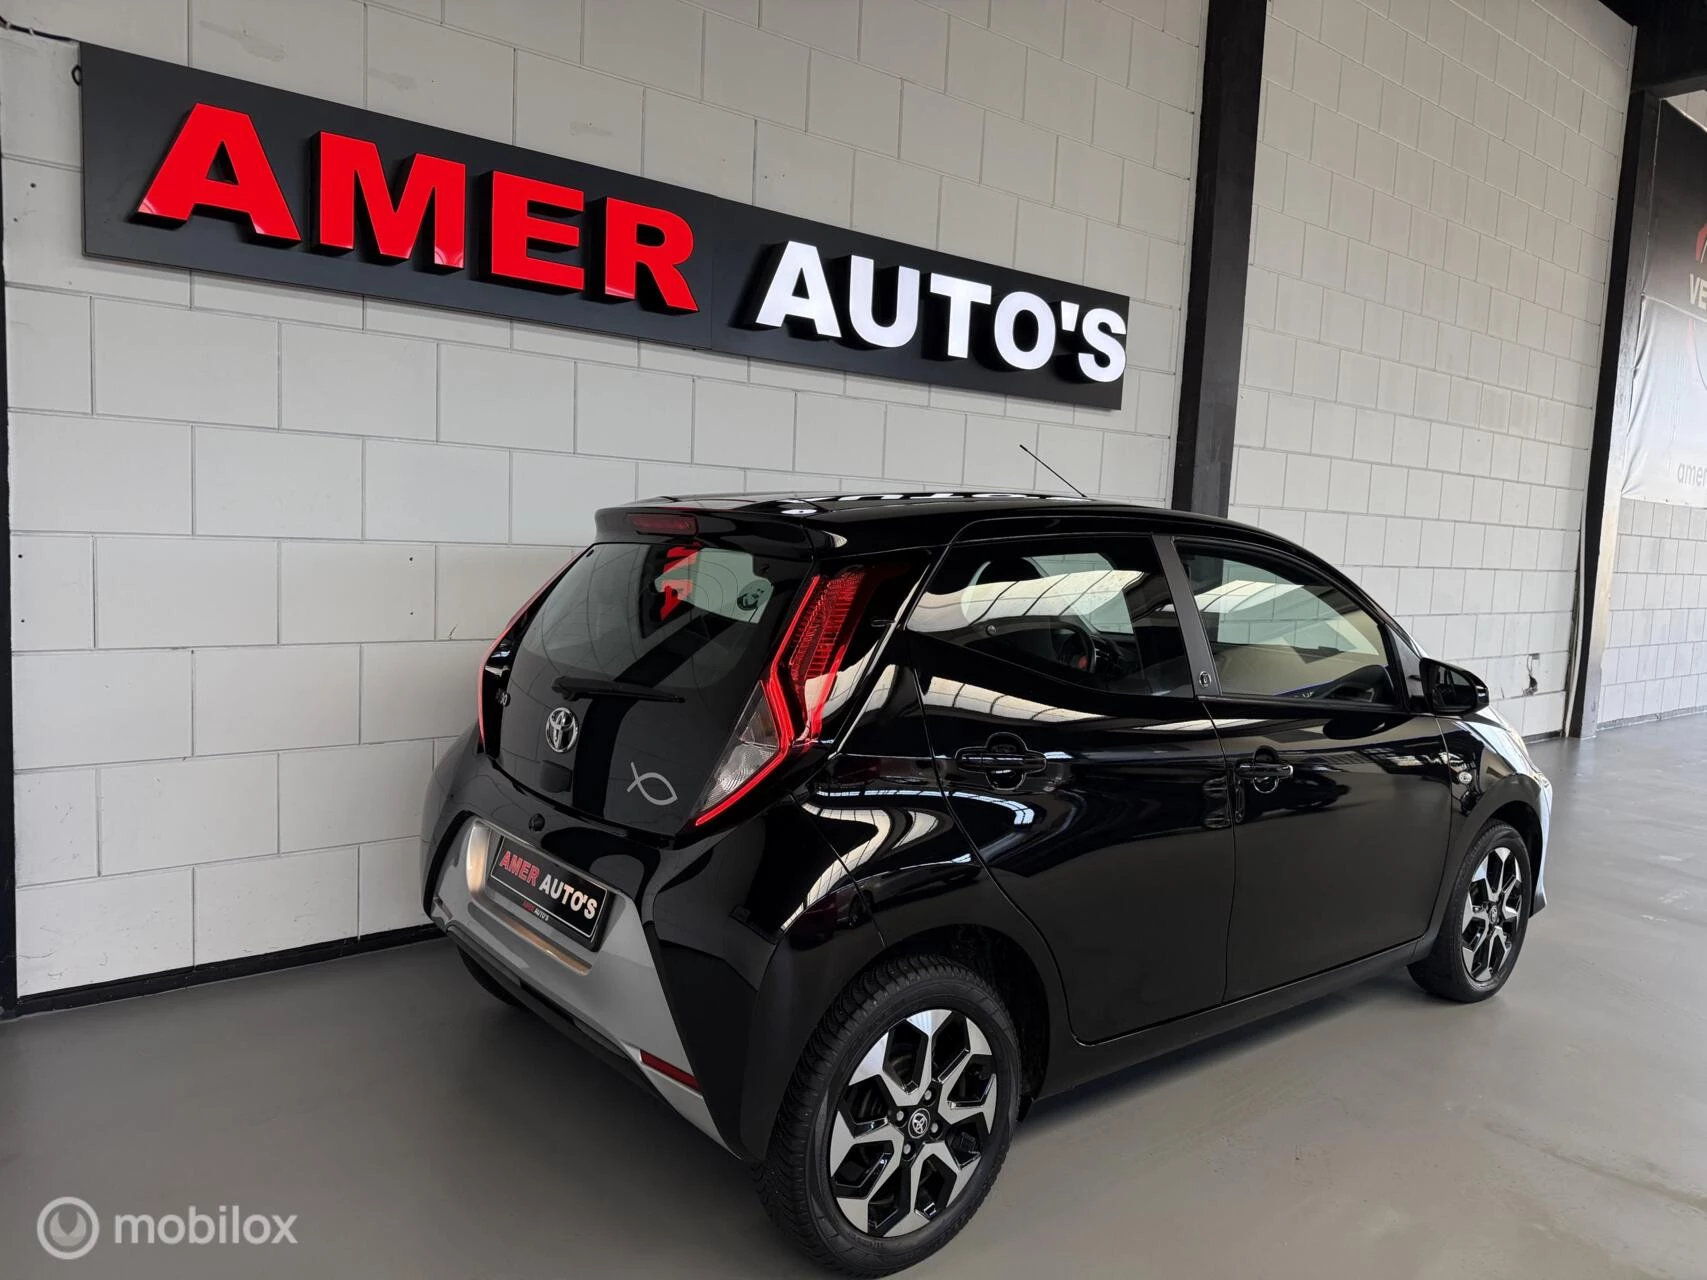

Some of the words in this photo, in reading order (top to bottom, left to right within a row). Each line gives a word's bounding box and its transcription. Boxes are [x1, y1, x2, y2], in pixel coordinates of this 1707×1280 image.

[137, 102, 699, 312] AMER
[755, 240, 1127, 383] AUTO'S
[500, 850, 541, 887] AMER
[539, 874, 598, 920] AUTO'S
